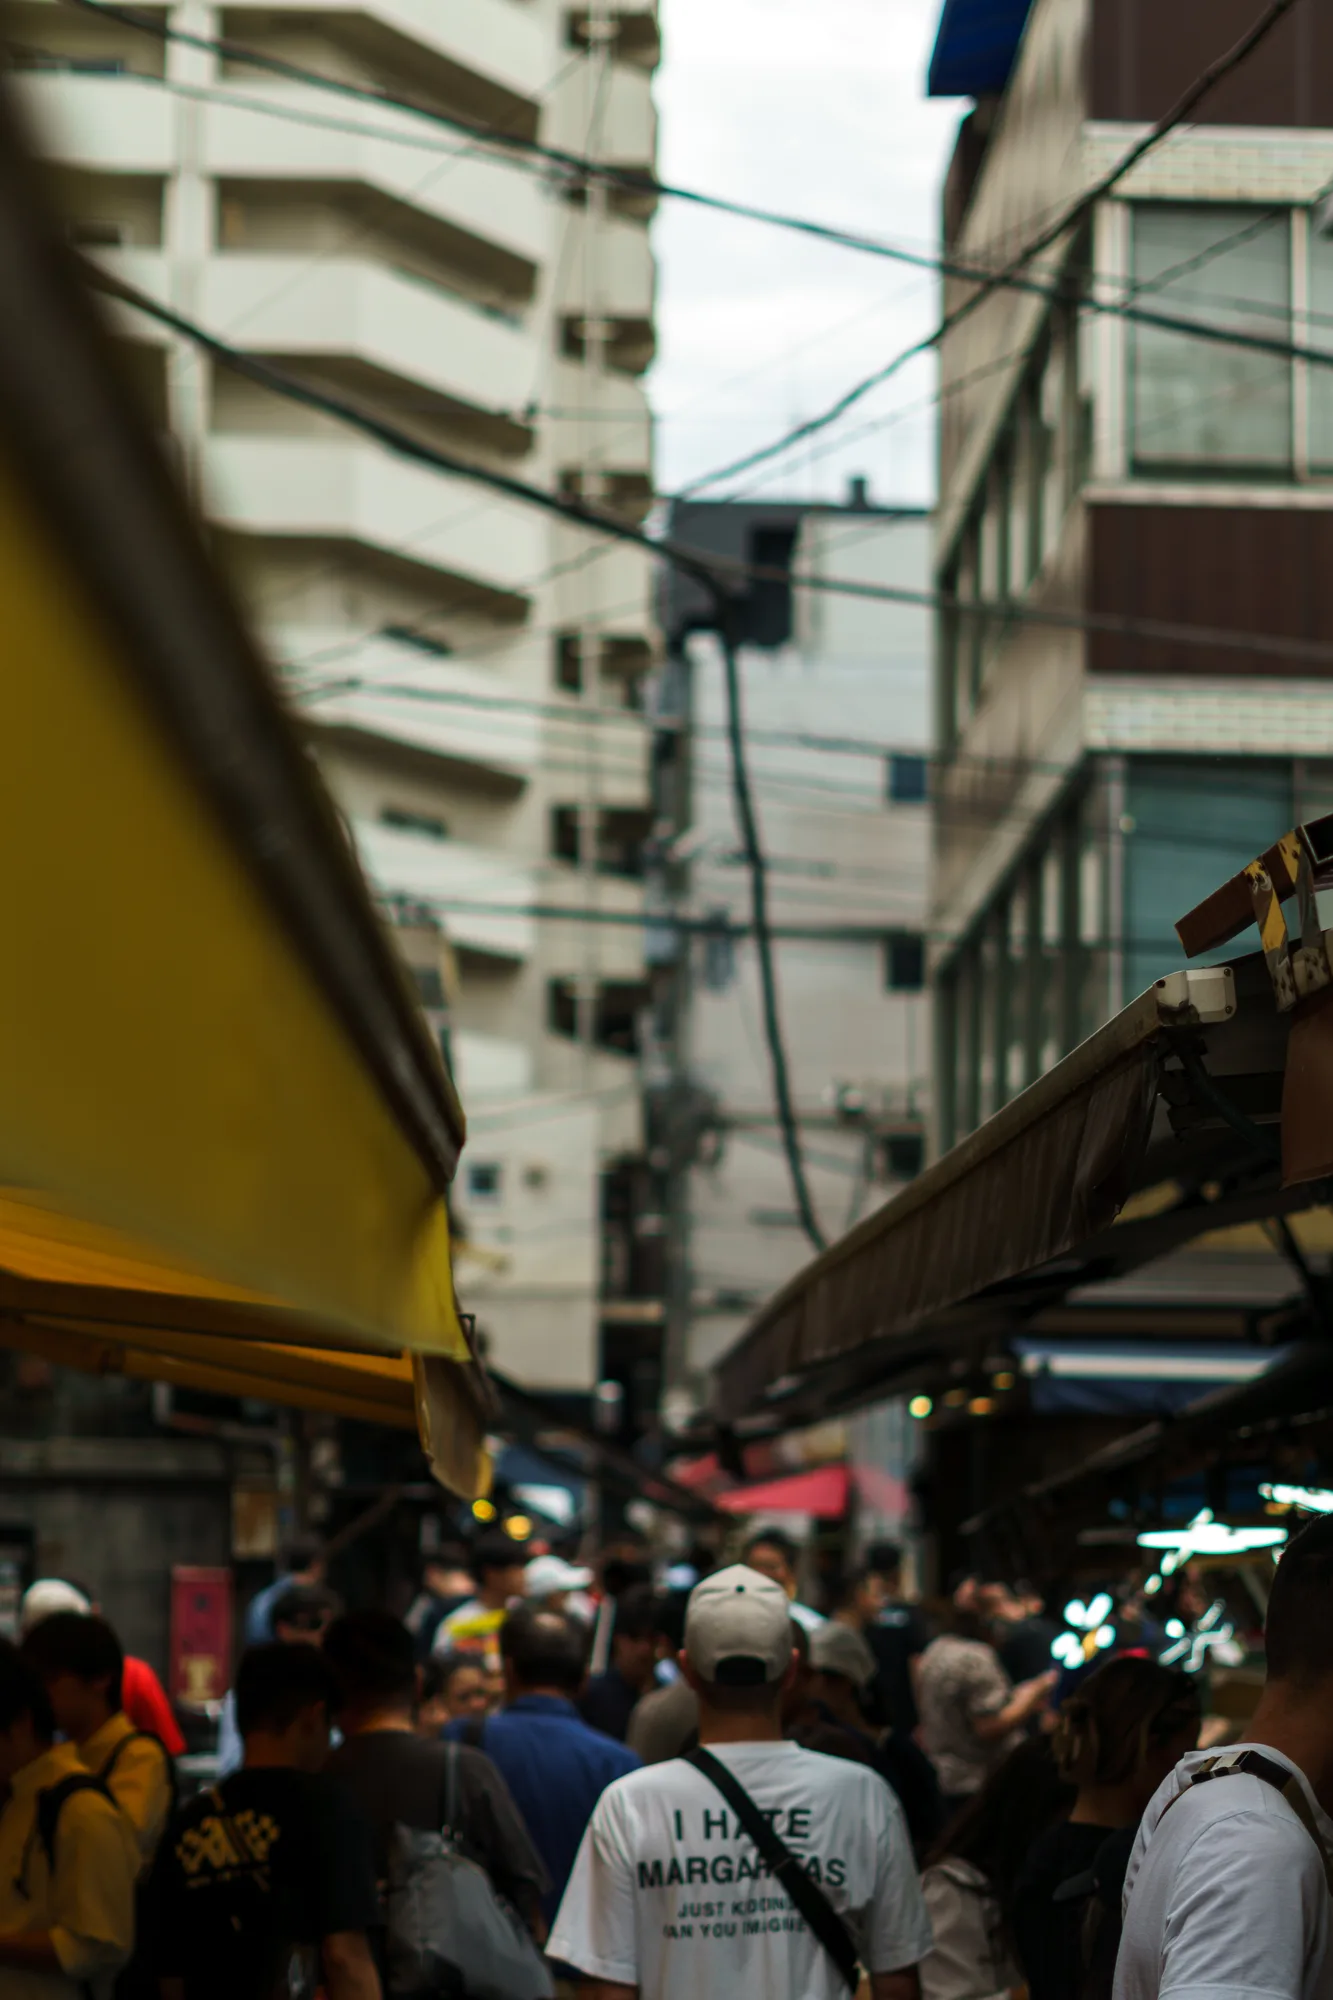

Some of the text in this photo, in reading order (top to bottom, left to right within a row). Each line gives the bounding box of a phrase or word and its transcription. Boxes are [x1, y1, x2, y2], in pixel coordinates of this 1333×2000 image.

[674, 1808, 683, 1841] I
[637, 1853, 847, 1889] MARGARAS
[678, 1901, 725, 1918] JUST
[699, 1921, 737, 1938] YOU
